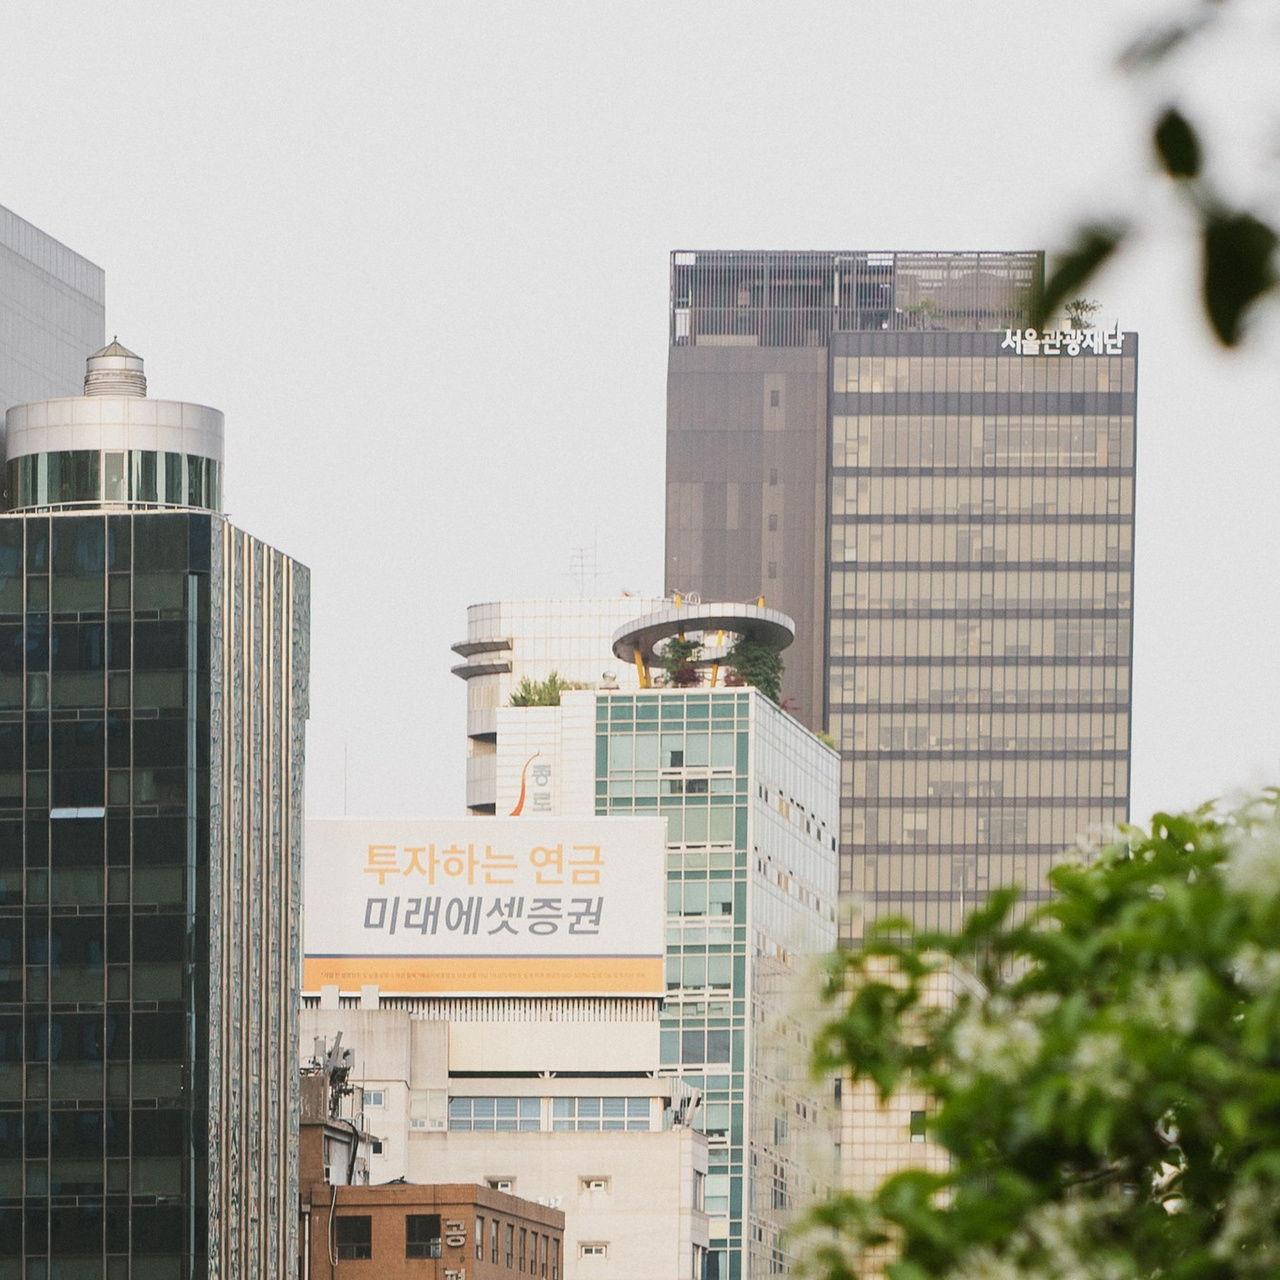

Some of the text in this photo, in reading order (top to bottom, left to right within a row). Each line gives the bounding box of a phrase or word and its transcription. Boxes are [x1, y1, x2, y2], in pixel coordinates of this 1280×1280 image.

[1001, 327, 1125, 356] 서울관광재단
[363, 843, 605, 886] 투자하는 연금
[363, 896, 605, 935] 미래에셋증권
